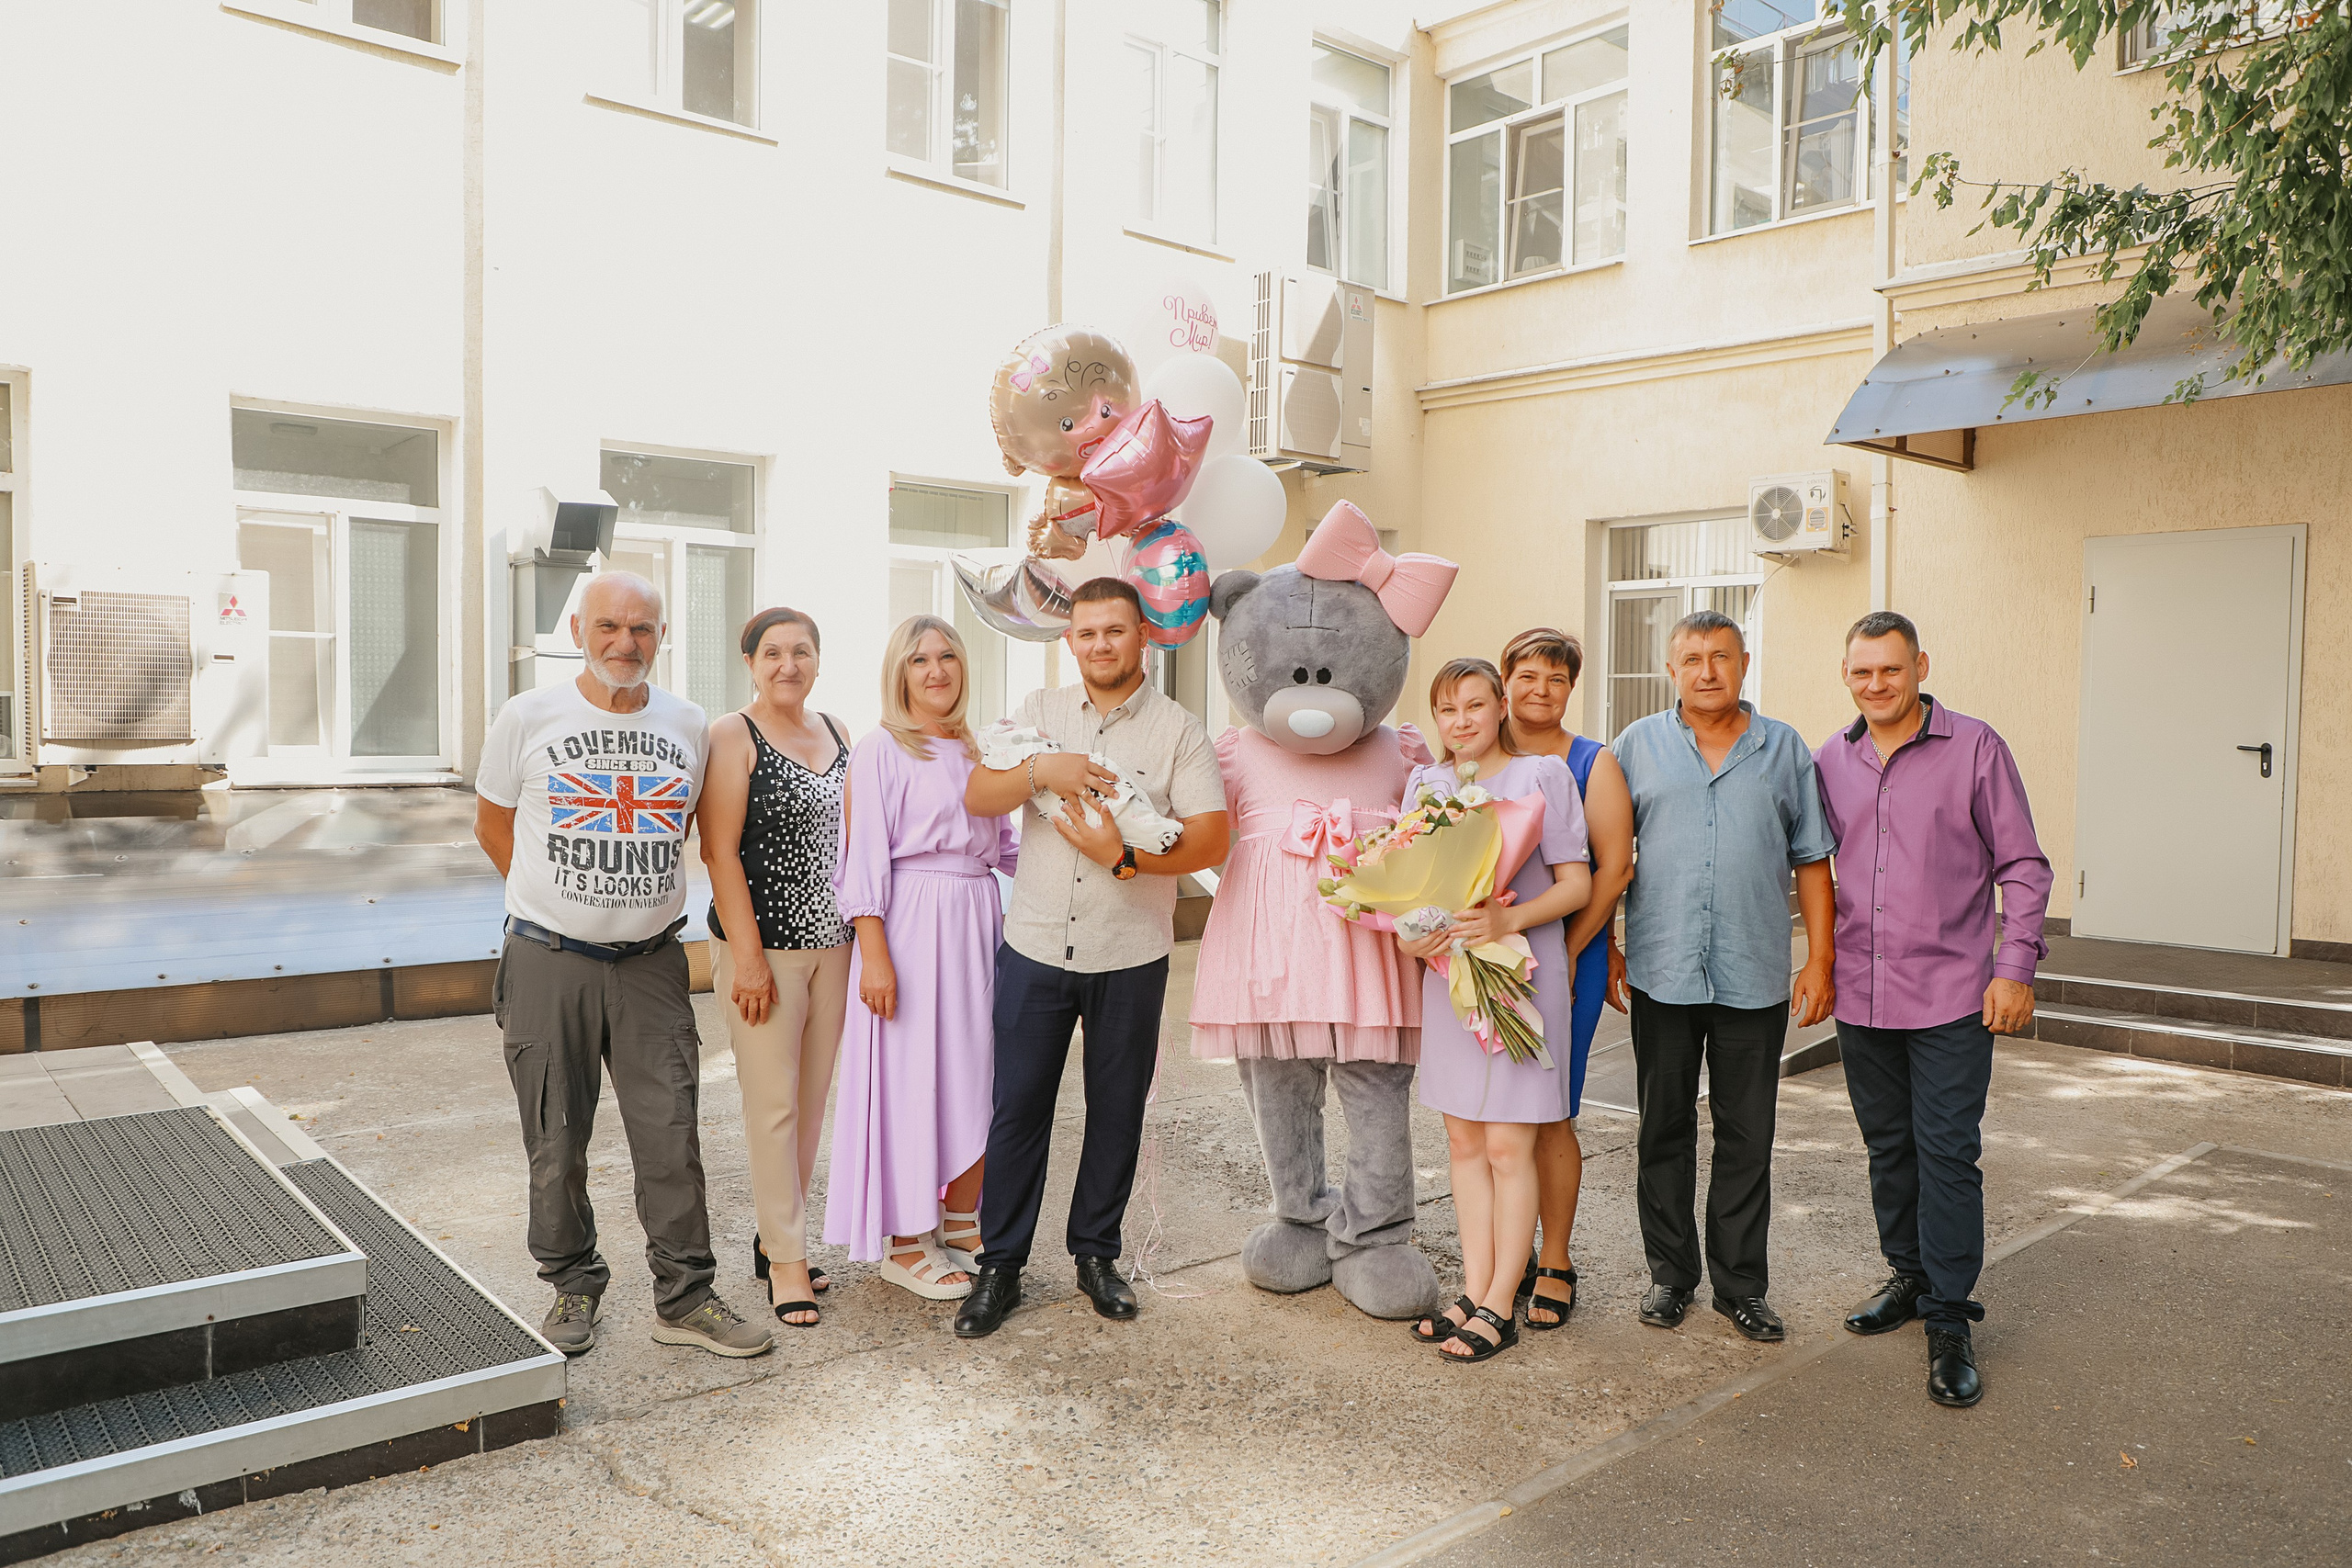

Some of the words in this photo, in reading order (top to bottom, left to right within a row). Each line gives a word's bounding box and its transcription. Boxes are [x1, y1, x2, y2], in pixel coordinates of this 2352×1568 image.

[1170, 320, 1214, 352] Мир!
[587, 759, 628, 771] SINCE
[629, 760, 654, 772] 860
[547, 832, 684, 874] ROUNDS
[594, 874, 652, 897] LOOKS
[657, 873, 676, 894] FOR
[561, 889, 627, 908] CONVERSATION
